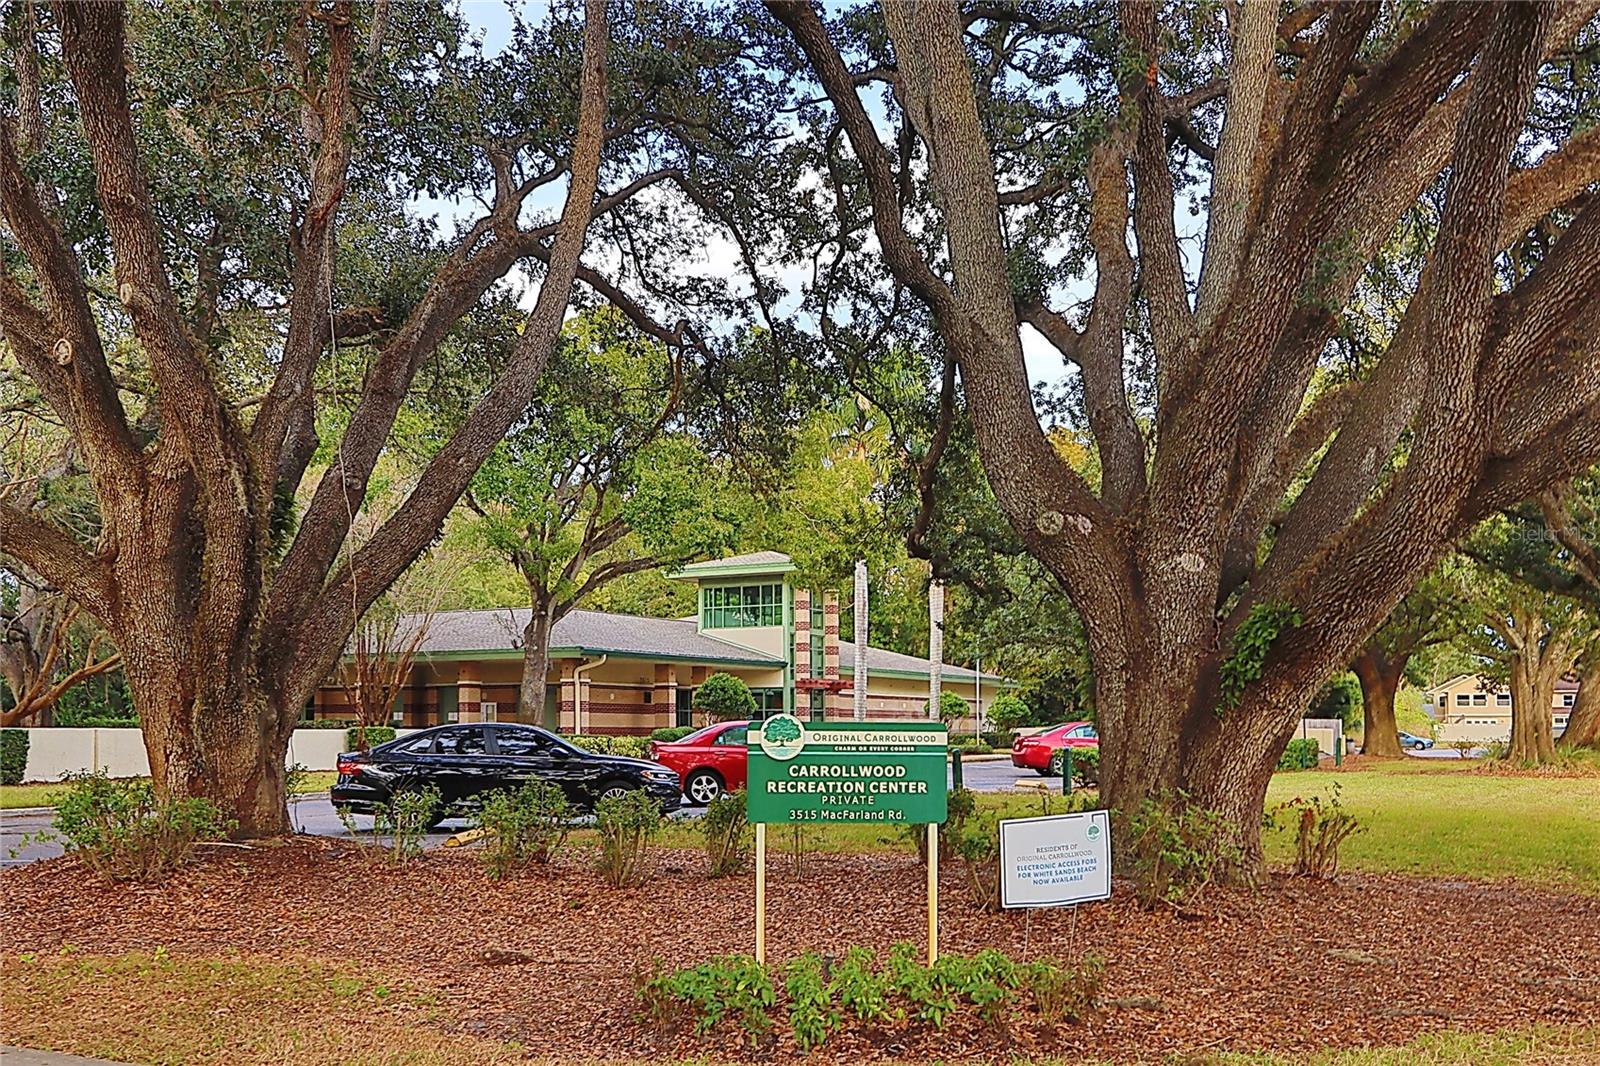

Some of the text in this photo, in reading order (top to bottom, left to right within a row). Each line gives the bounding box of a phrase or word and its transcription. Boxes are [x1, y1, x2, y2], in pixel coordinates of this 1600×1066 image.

[788, 765, 906, 778] CARROLLWOOD
[767, 781, 928, 794] RECREATION CENTER
[821, 795, 875, 805] PRIVATE
[789, 809, 907, 820] 3515 MacFarland Rd.
[1036, 843, 1078, 853] RESIDENTS OF
[1016, 849, 1093, 863] ORIGINAL CARROLLWOOD
[1016, 857, 1097, 872] ELECTRONIC ACCESS FOBS
[1017, 865, 1097, 878] FOR WHITE SANDS BEACH
[1051, 874, 1083, 884] AVAILABLE
